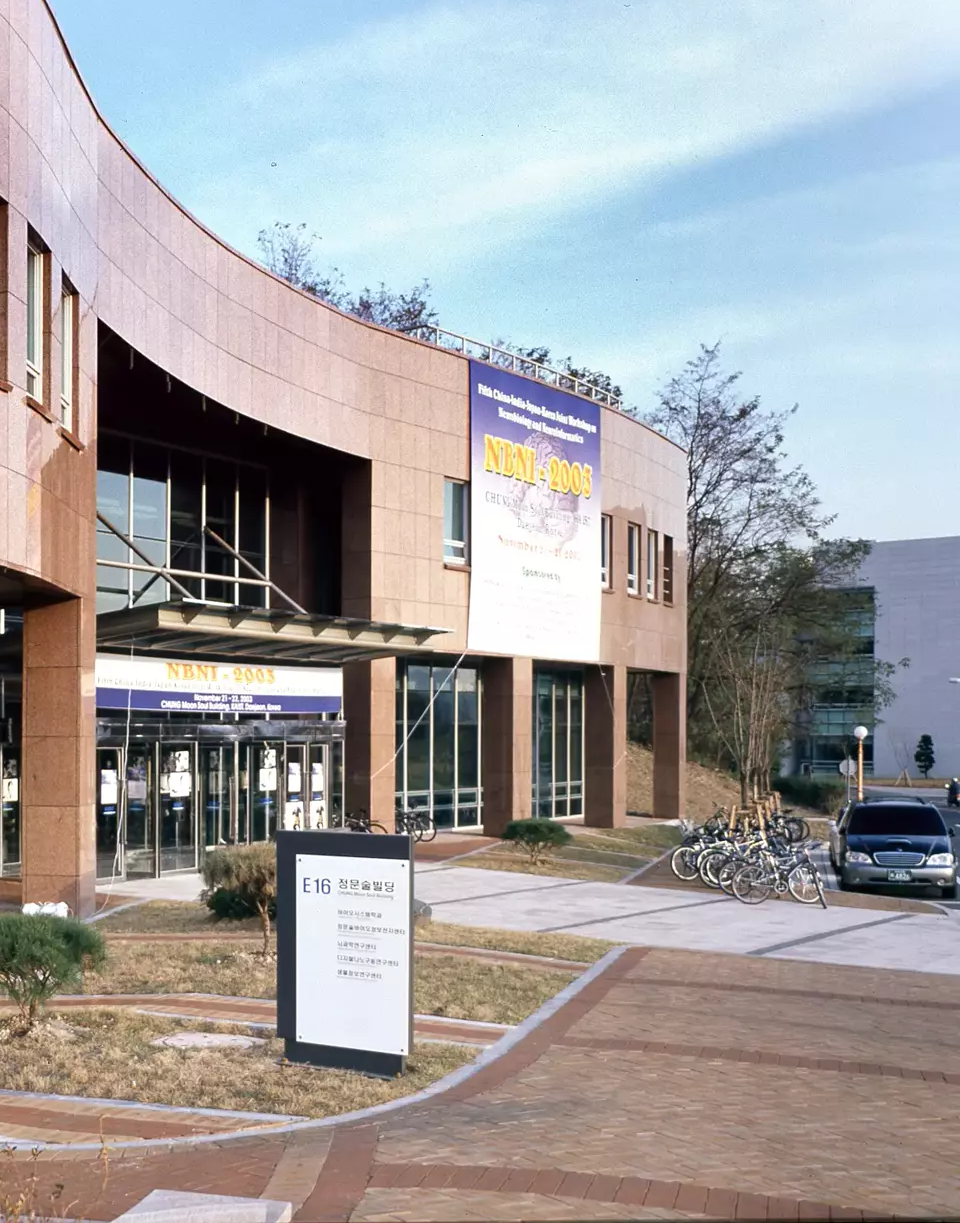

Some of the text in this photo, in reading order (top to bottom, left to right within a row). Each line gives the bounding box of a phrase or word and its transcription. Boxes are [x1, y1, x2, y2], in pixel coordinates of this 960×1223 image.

[532, 421, 542, 432] and
[568, 415, 591, 433] Workshop
[483, 434, 537, 486] NBNI
[548, 456, 593, 499] 2003
[164, 662, 218, 682] NBNI
[233, 666, 276, 684] 2003
[161, 700, 181, 709] CHUNG
[182, 701, 197, 709] Moon
[194, 693, 221, 702] November
[303, 877, 331, 895] E16
[338, 878, 395, 893] 정문술빌딩
